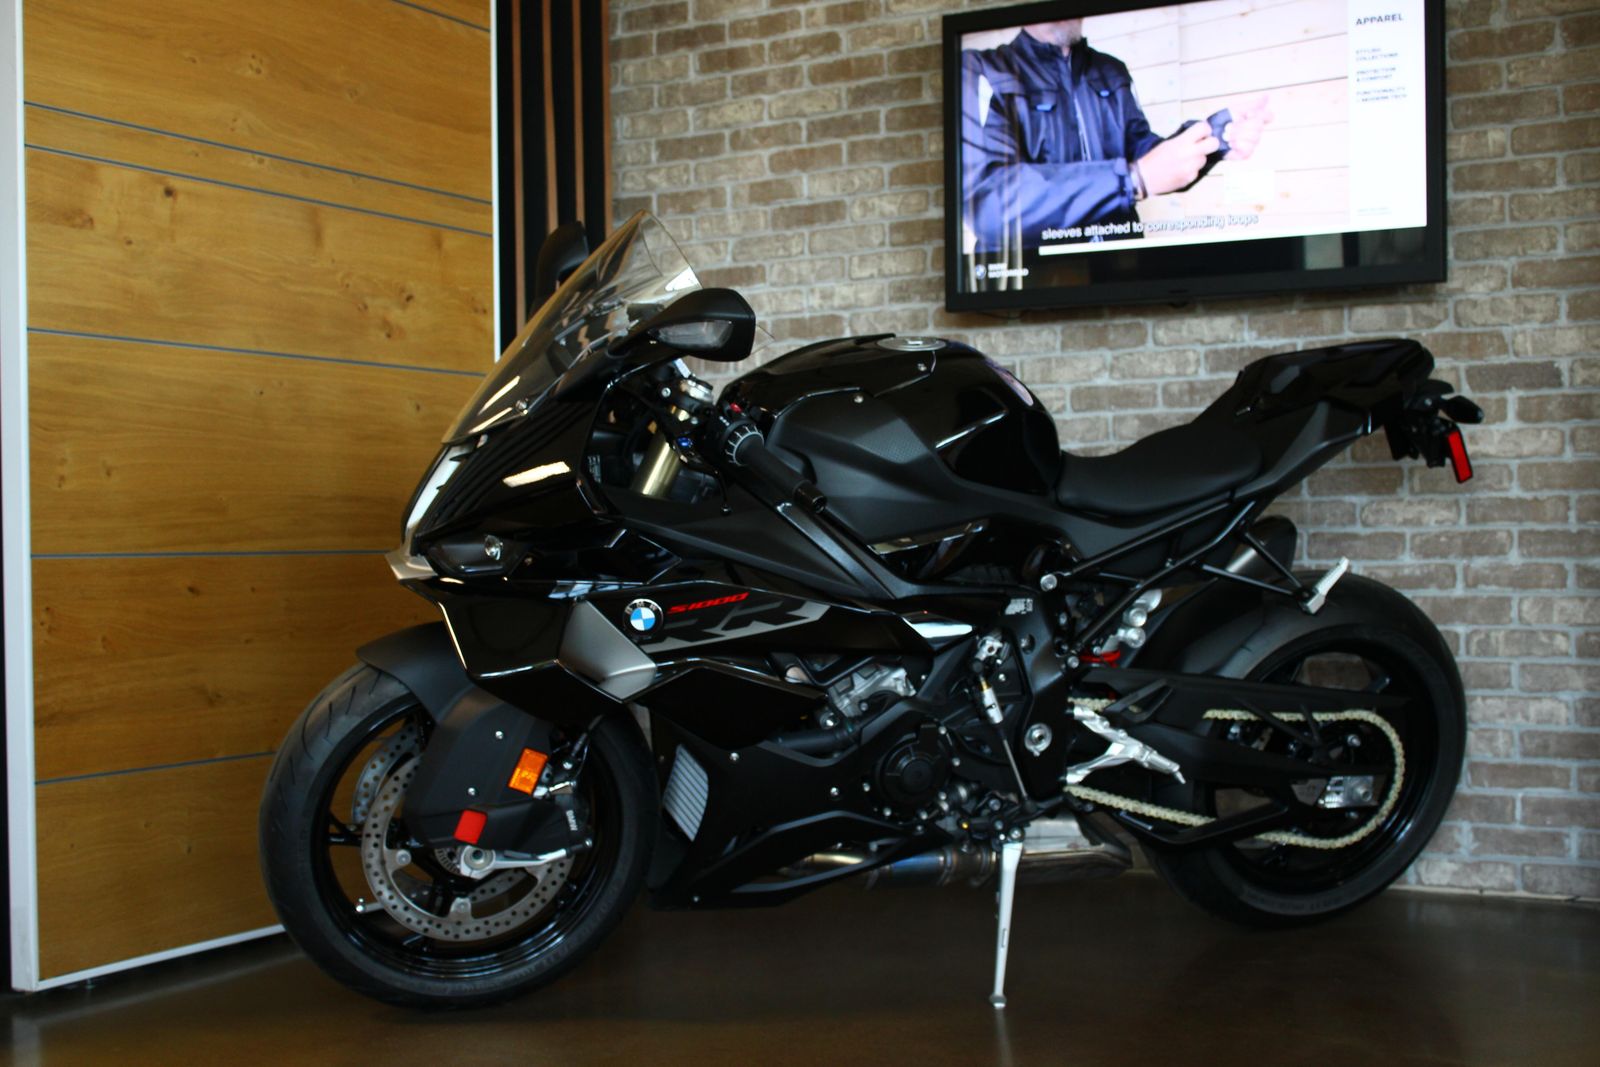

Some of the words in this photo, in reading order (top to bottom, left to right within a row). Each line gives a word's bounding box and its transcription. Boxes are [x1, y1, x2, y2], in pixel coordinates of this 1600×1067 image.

[1356, 13, 1403, 25] APPAREL
[1041, 227, 1082, 240] sleeves
[1084, 221, 1130, 237] attached
[1132, 221, 1144, 233] to
[1147, 214, 1225, 233] corresponding
[1227, 213, 1259, 227] loops
